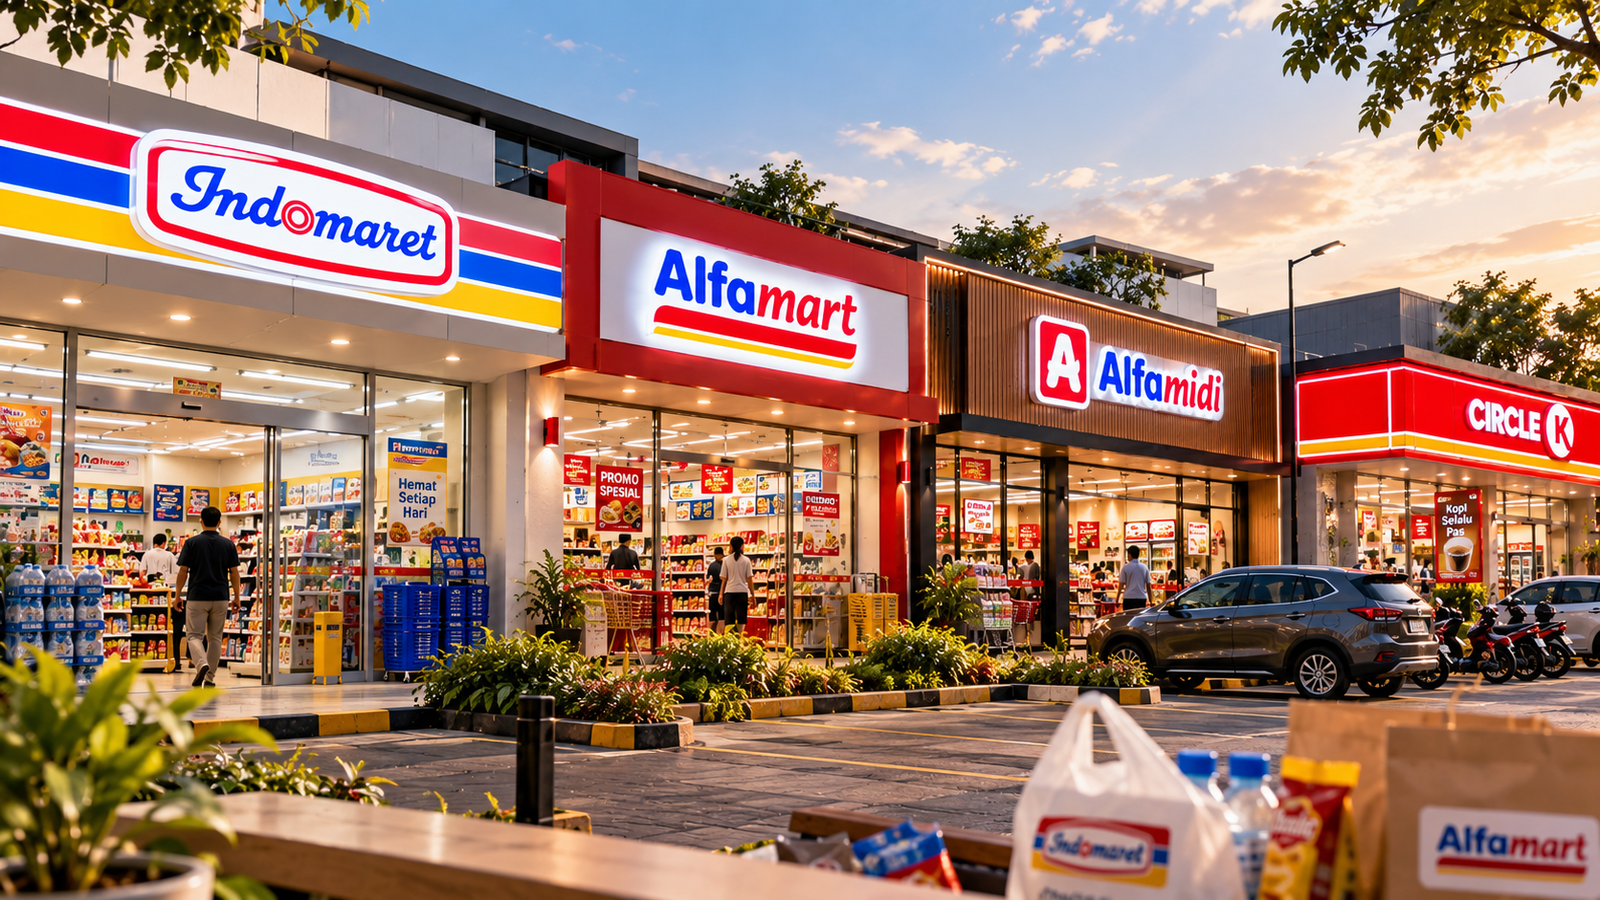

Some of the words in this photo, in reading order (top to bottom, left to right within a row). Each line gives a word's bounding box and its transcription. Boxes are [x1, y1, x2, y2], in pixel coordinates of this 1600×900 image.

[170, 165, 437, 261] Indomaret
[654, 248, 858, 336] Alfamart
[1046, 332, 1082, 393] A
[1098, 351, 1221, 412] Alfamidi
[1468, 398, 1541, 442] CIRCLE
[1553, 413, 1574, 453] K
[398, 477, 437, 491] Hemat
[600, 471, 639, 485] PROMO
[398, 491, 436, 508] Setiap
[600, 485, 641, 499] SPESIAL
[403, 506, 428, 518] Hari
[1446, 526, 1465, 537] Pas
[1436, 824, 1588, 862] Alfamart
